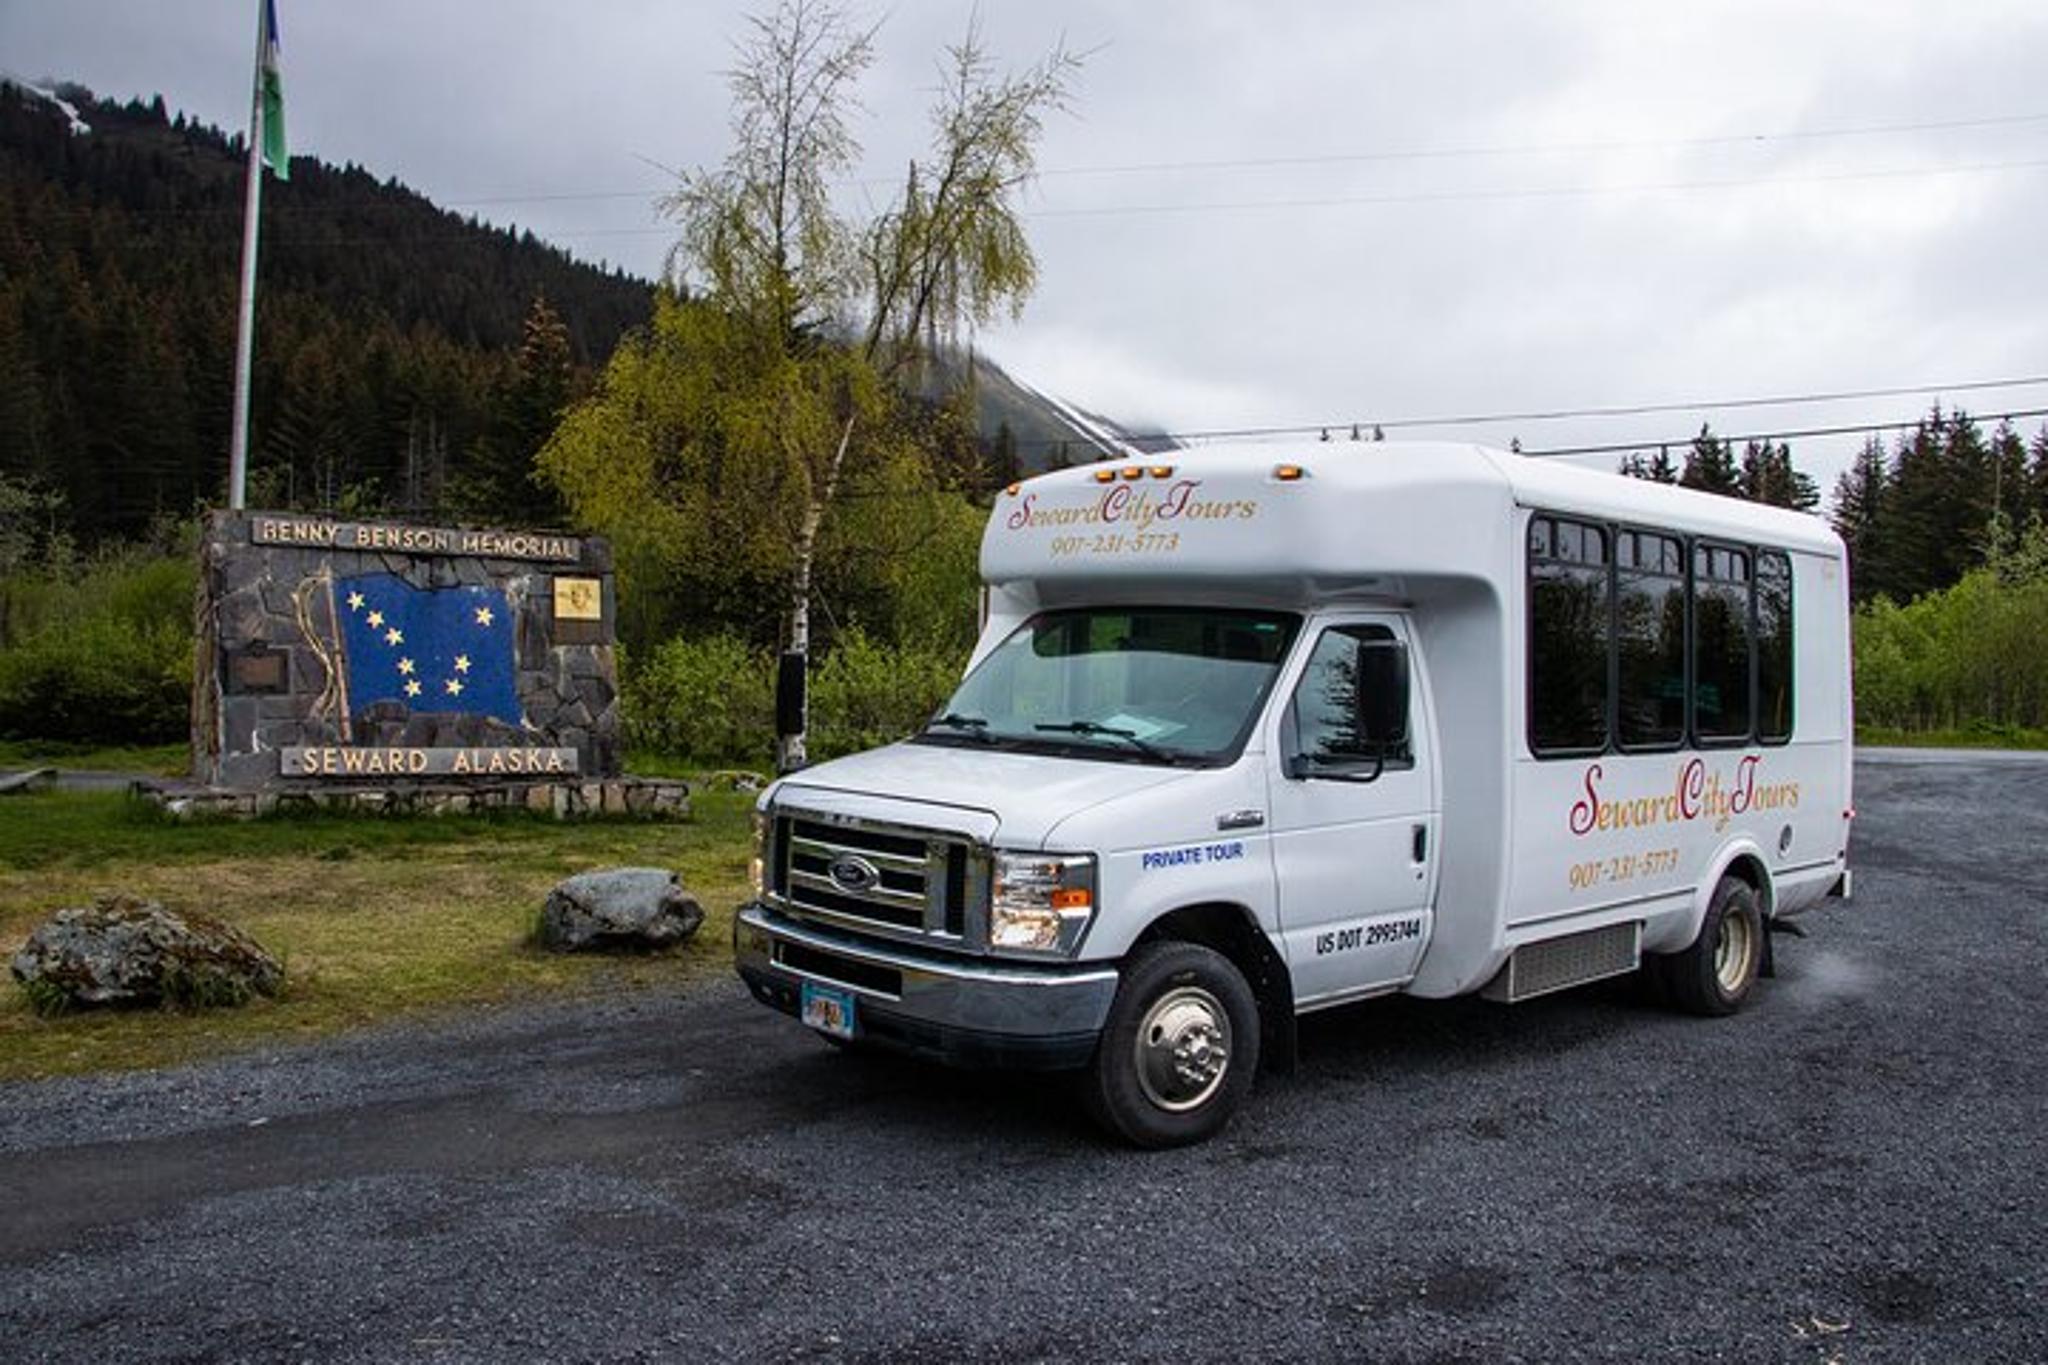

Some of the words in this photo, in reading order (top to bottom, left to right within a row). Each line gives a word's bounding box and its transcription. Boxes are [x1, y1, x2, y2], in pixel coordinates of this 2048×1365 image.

[357, 526, 449, 550] BENSON
[462, 535, 575, 559] MEMORIAL
[1052, 533, 1180, 556] 907-231-5773
[303, 749, 428, 774] SEWARD
[455, 748, 564, 774] ALASKA
[1143, 847, 1201, 870] PRIVATE
[1206, 841, 1244, 861] TOUR
[1570, 849, 1679, 889] 907-231-5773
[1316, 934, 1336, 955] US
[1337, 927, 1363, 951] DOT
